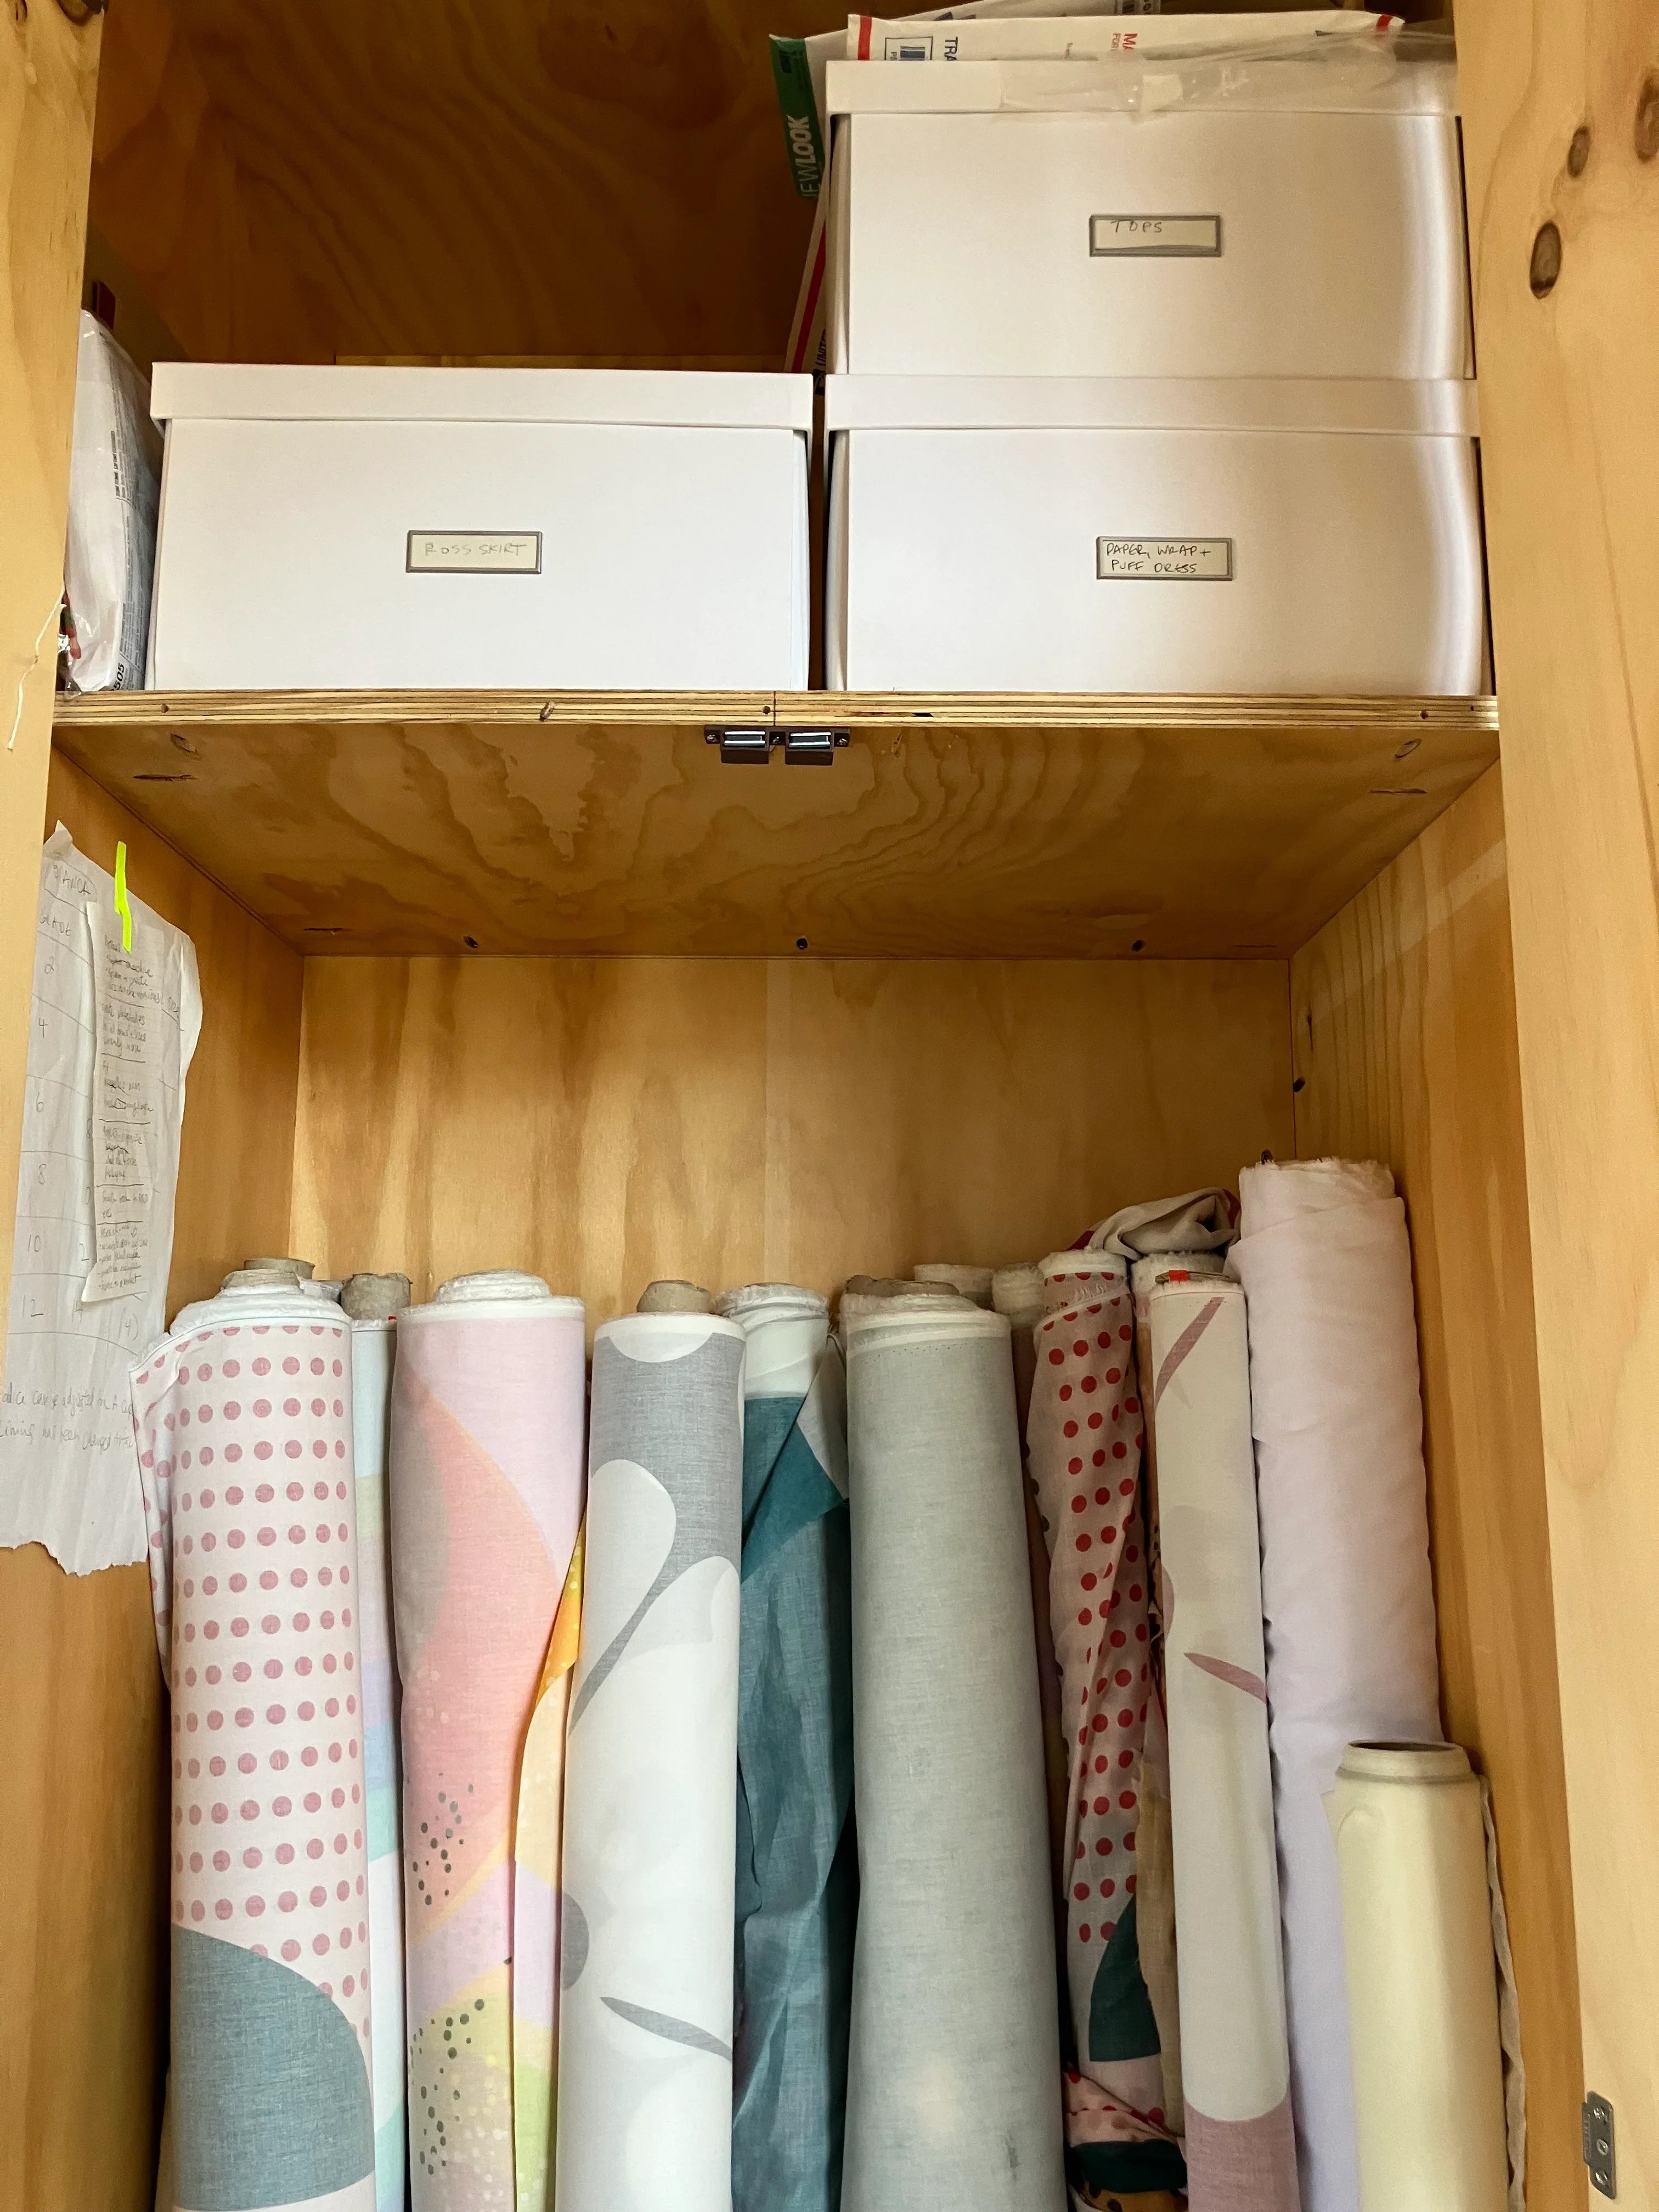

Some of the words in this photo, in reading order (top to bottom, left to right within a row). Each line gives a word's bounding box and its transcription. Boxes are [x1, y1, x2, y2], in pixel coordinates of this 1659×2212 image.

[1110, 220, 1163, 233] TOPS
[424, 541, 472, 556] ROSS
[478, 543, 527, 556] SKIRT
[1157, 545, 1198, 556] WRAP
[1200, 548, 1211, 557] +
[1111, 559, 1144, 572] PUFF
[1154, 563, 1198, 573] DRESS
[38, 1017, 48, 1039] 4
[36, 1092, 44, 1113] 6
[38, 1163, 47, 1185] 8
[28, 1234, 42, 1252] 10
[22, 1295, 44, 1318] 12
